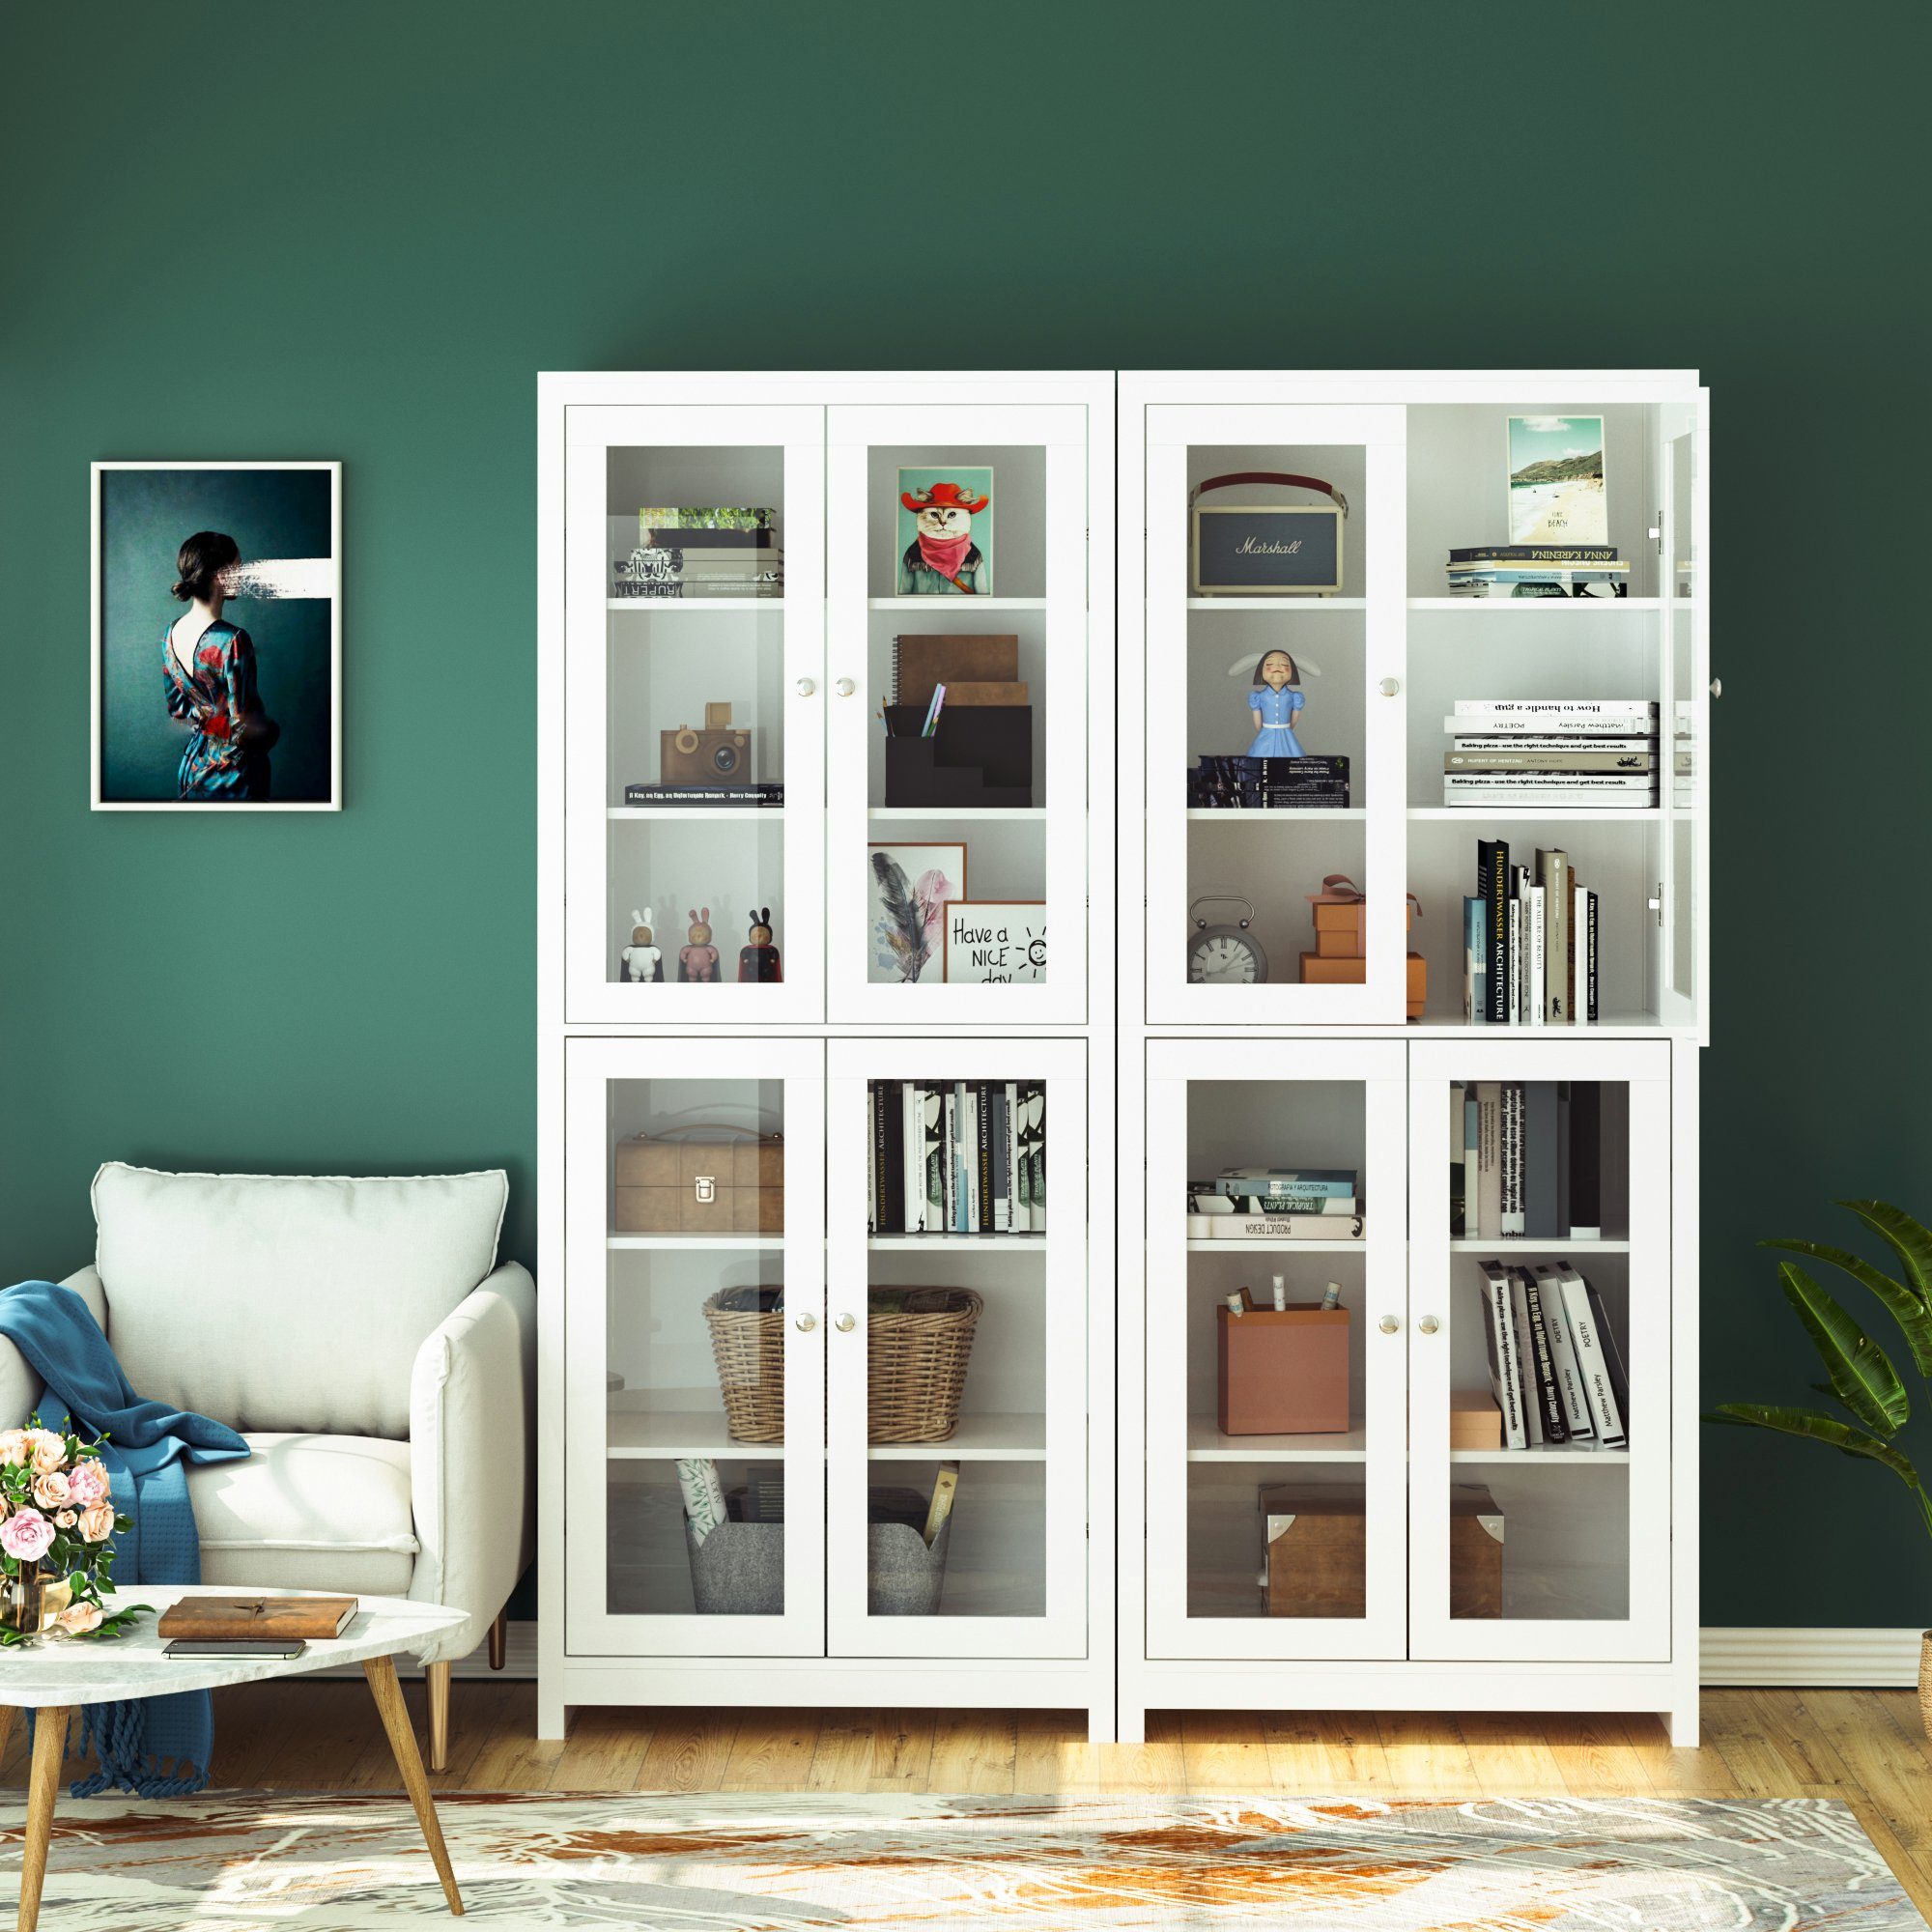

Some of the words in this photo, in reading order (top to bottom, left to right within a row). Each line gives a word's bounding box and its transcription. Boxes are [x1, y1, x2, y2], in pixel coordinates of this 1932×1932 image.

[1236, 536, 1302, 554] Marshall
[1532, 551, 1581, 559] KARENINA
[1584, 551, 1613, 559] ANNA
[623, 584, 676, 596] RUPERT
[1495, 850, 1505, 940] HUNDERTWASSER
[952, 918, 976, 945] Have
[997, 927, 1009, 943] a
[1536, 934, 1542, 943] OF
[972, 947, 1009, 967] NICE
[1495, 942, 1505, 1020] ARCHITECTURE
[1245, 1224, 1265, 1235] DESIGN
[1266, 1224, 1291, 1235] PRODUCT
[1551, 1318, 1562, 1343] POETRY
[1578, 1321, 1591, 1347] POETRY
[1536, 1331, 1548, 1362] Unfortunate
[1503, 1355, 1513, 1380] technique
[1541, 1362, 1552, 1382] Remark
[1564, 1368, 1575, 1389] Parsley
[1594, 1374, 1605, 1397] Parsley
[1545, 1385, 1555, 1401] Harry
[1569, 1391, 1580, 1419] Matthew
[1600, 1397, 1613, 1427] Matthew
